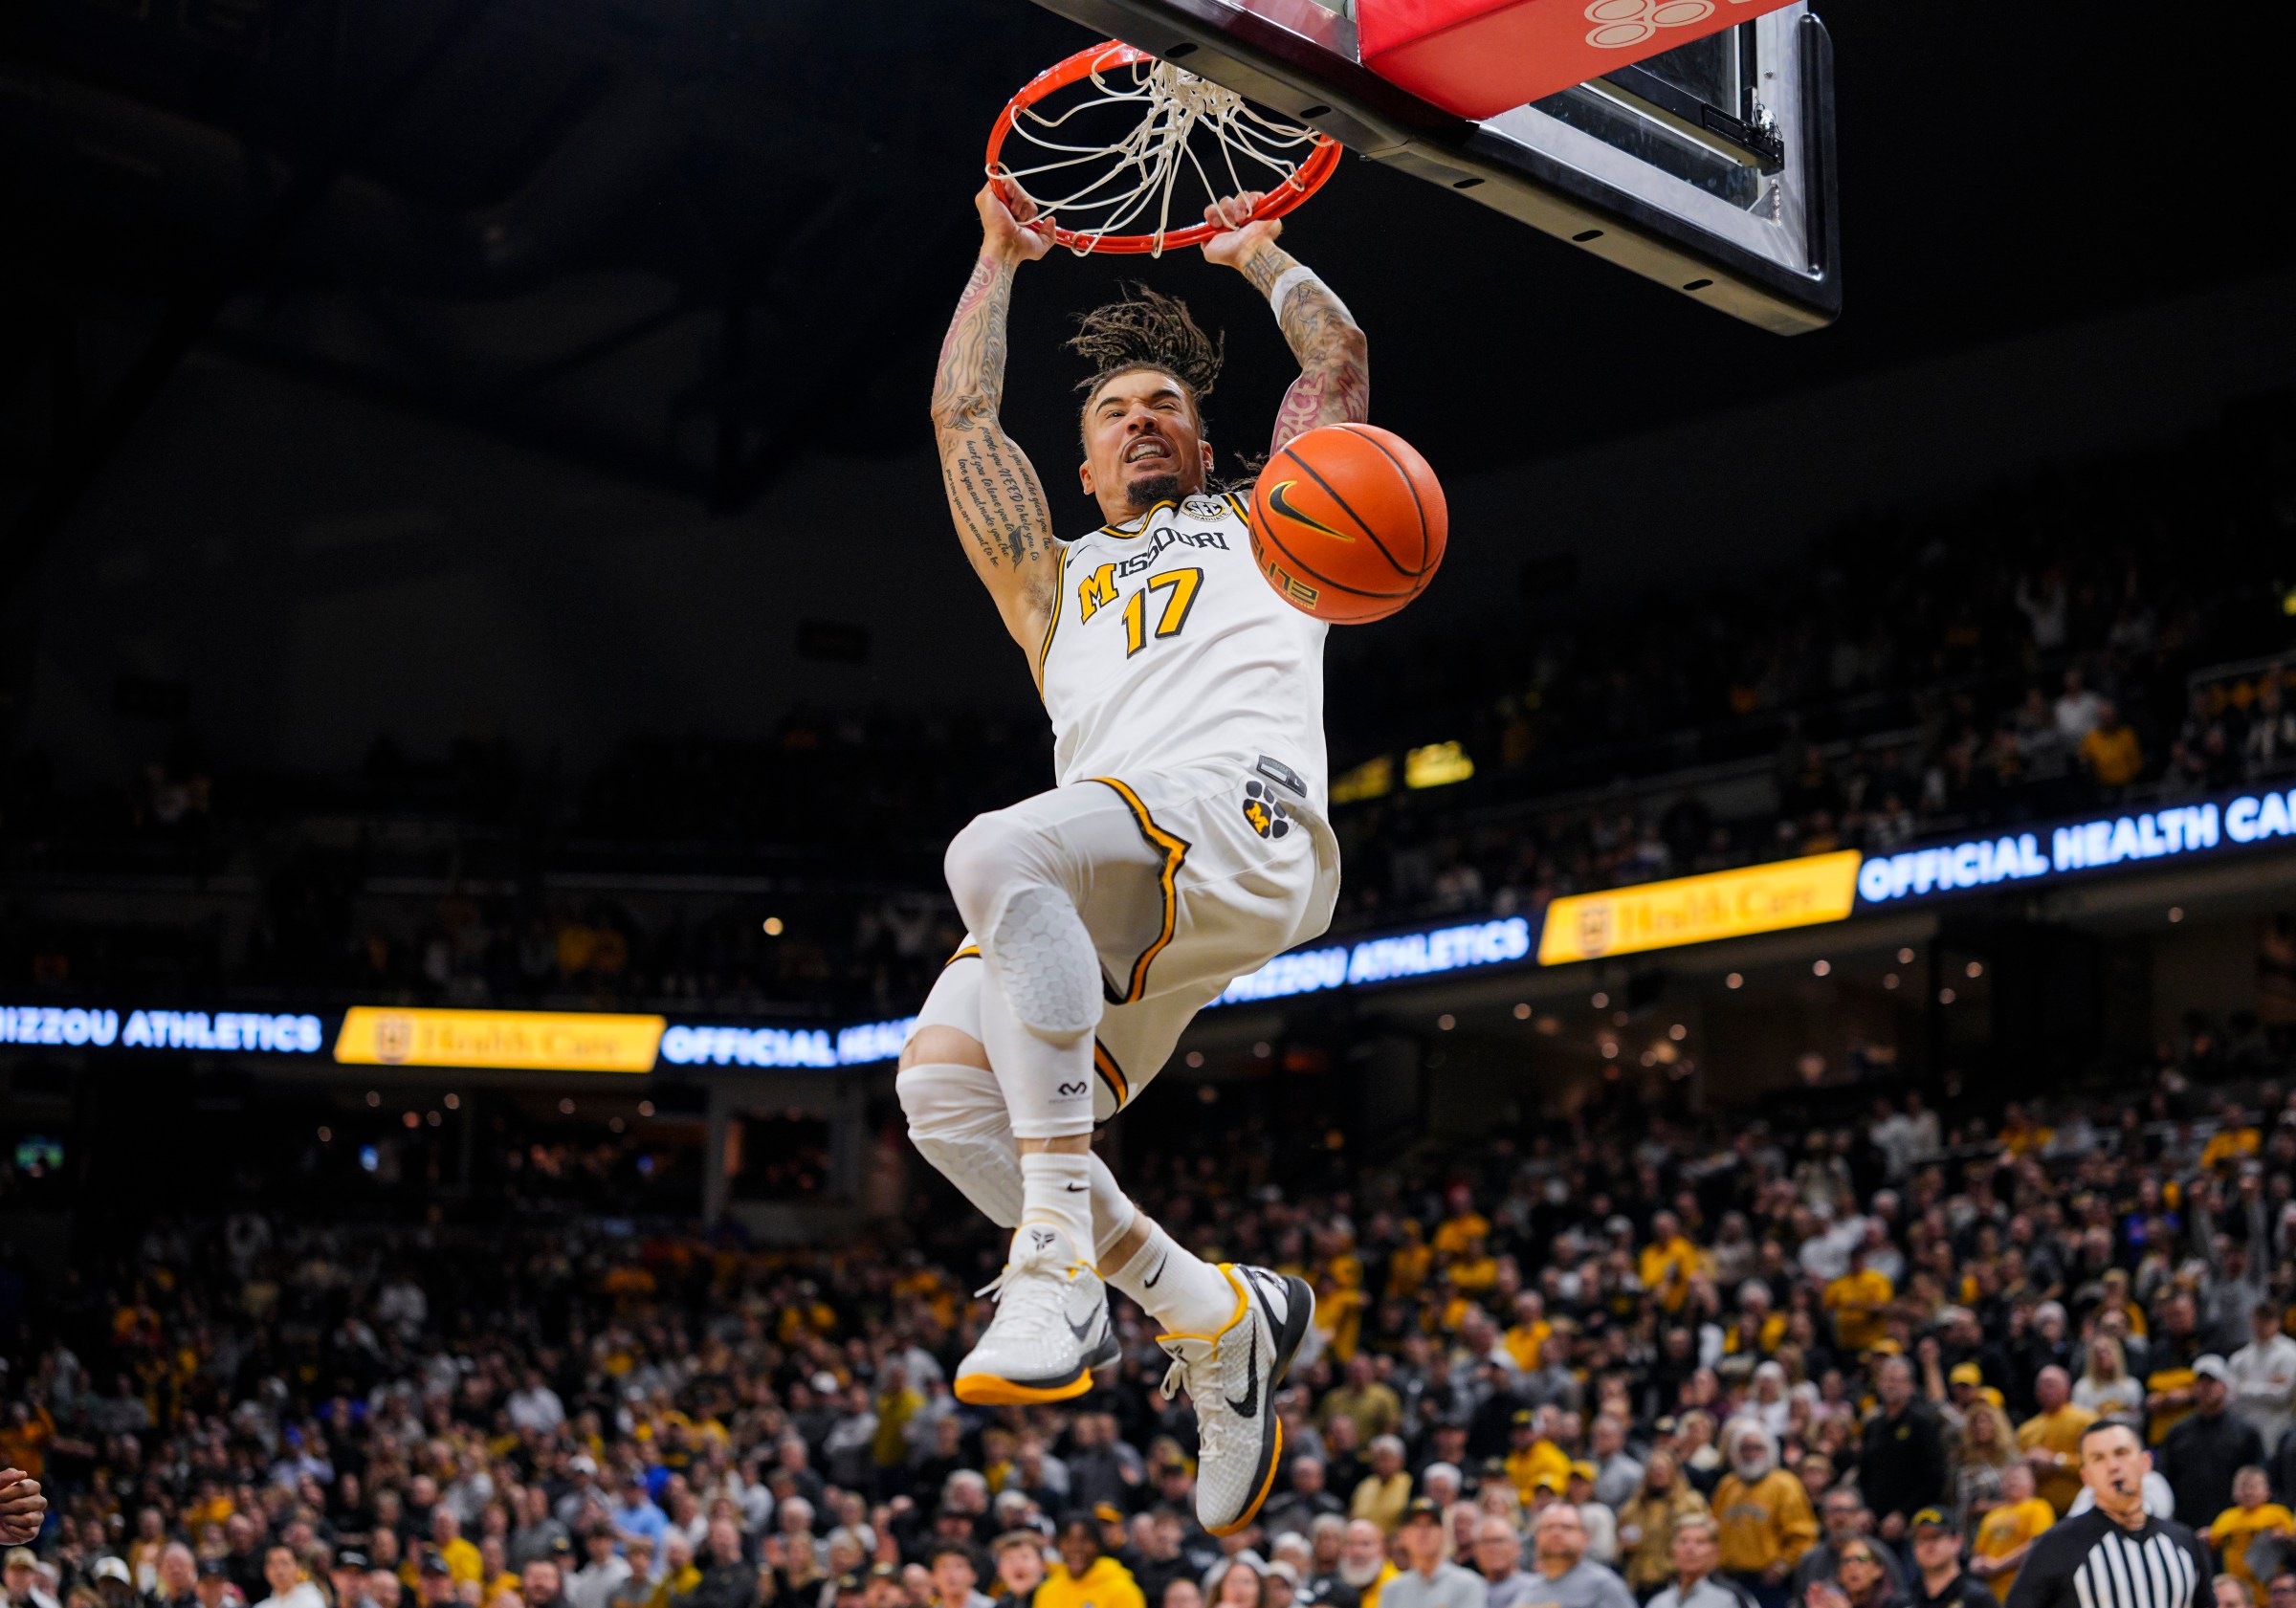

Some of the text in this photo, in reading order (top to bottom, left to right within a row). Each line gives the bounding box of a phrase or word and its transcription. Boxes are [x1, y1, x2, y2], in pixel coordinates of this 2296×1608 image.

[946, 469, 1000, 567] person you are meant to be
[958, 458, 1010, 557] love you and make you the
[966, 440, 1015, 533] hurt you to leave you to
[978, 426, 1040, 562] people you NEED to help you to
[1028, 497, 1045, 518] gives
[1186, 501, 1223, 517] SEC
[1188, 512, 1229, 521] GRADUATE
[1035, 518, 1049, 534] you
[1043, 537, 1051, 551] the
[1078, 527, 1230, 626] MISSOURI
[1249, 521, 1319, 606] ELITE
[1121, 567, 1204, 659] 17
[1246, 802, 1269, 834] M
[1858, 832, 2050, 903] OFFICIAL
[2053, 802, 2219, 872] HEALTH
[1348, 916, 1530, 985] ATHLETICS
[0, 1004, 323, 1053] IZZOU ATHLETICS
[660, 1024, 838, 1068] OFFICIAL
